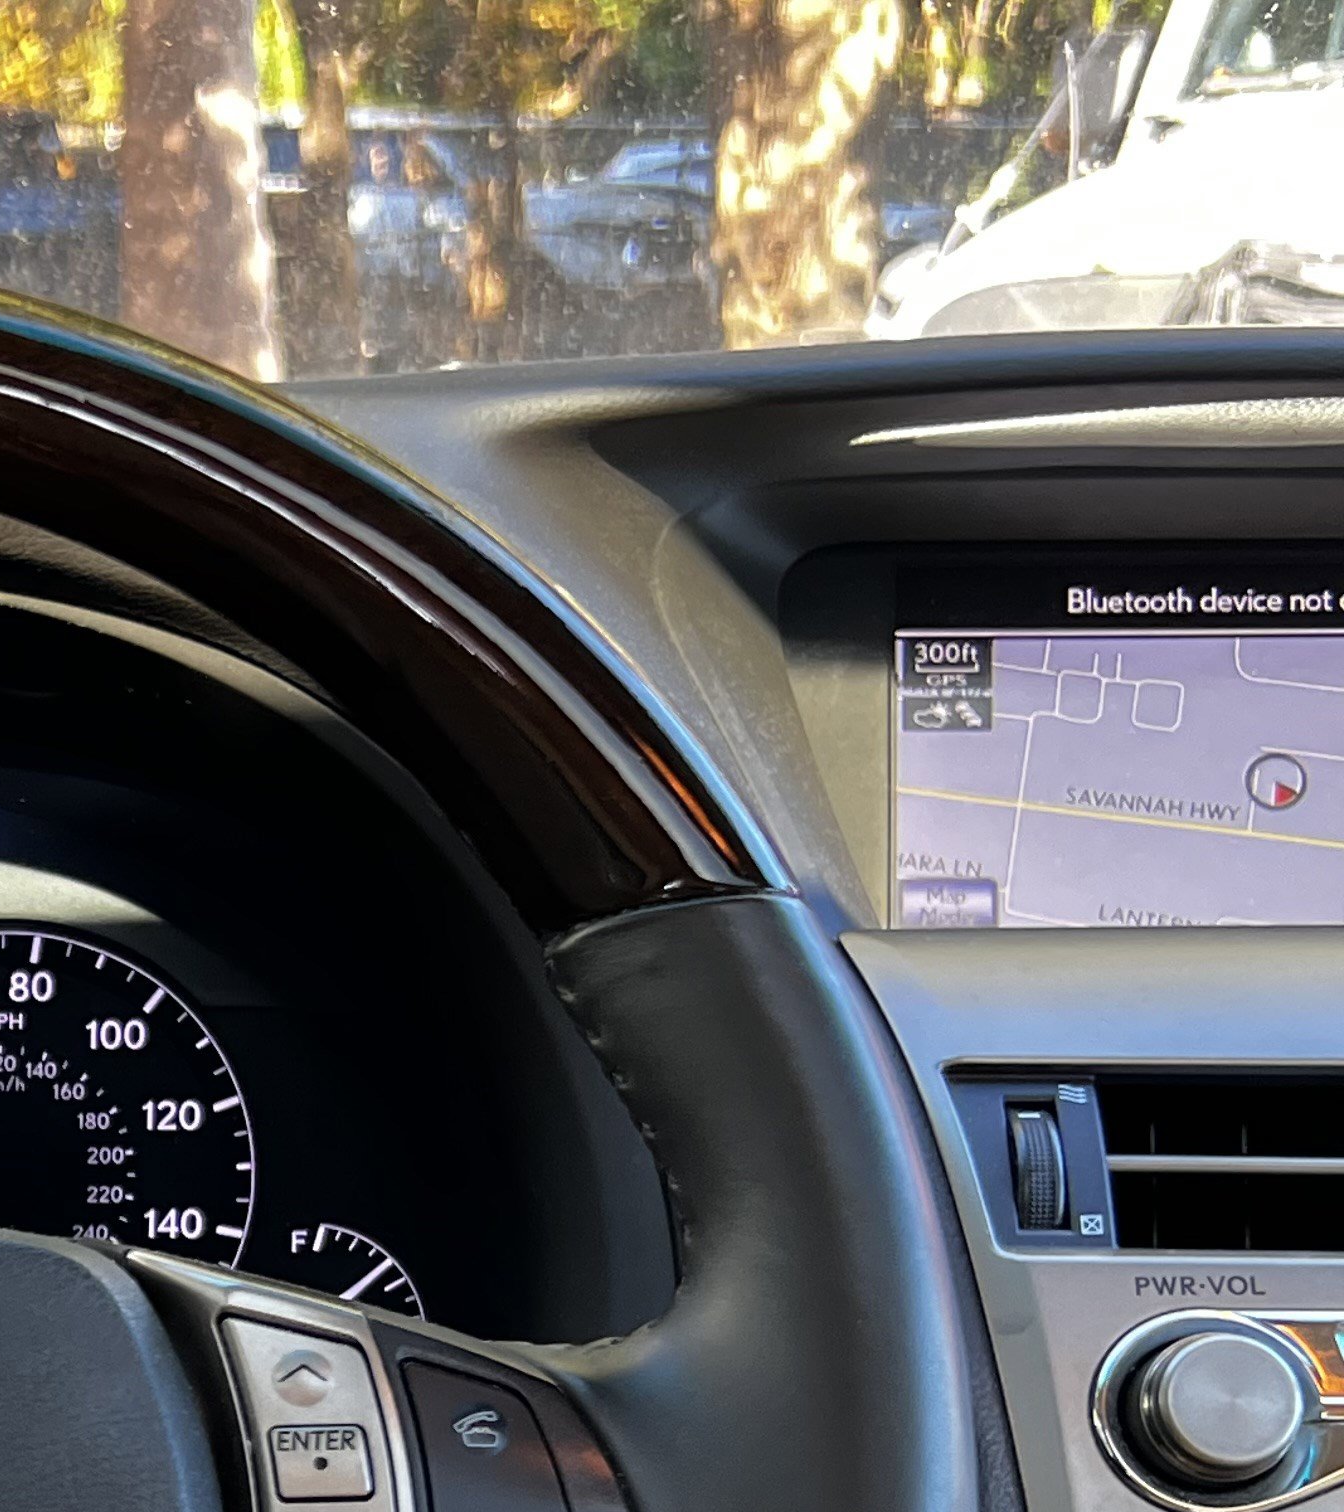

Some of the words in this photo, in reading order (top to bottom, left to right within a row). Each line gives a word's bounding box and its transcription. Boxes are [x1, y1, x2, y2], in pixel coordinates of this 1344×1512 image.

[1067, 587, 1192, 614] Bluetooth
[1199, 586, 1283, 613] device
[1289, 589, 1334, 613] not
[1066, 786, 1183, 817] SAVANNAH
[1189, 800, 1240, 821] HWY
[10, 971, 54, 1002] 80
[85, 1018, 148, 1050] 100
[26, 1061, 58, 1080] 140
[53, 1082, 86, 1101] 160
[77, 1112, 110, 1131] 180
[141, 1100, 203, 1132] 120
[86, 1147, 125, 1166] 200
[86, 1185, 123, 1204] 220
[143, 1207, 204, 1239] 140
[291, 1229, 308, 1254] F
[276, 1430, 356, 1451] ENTER
